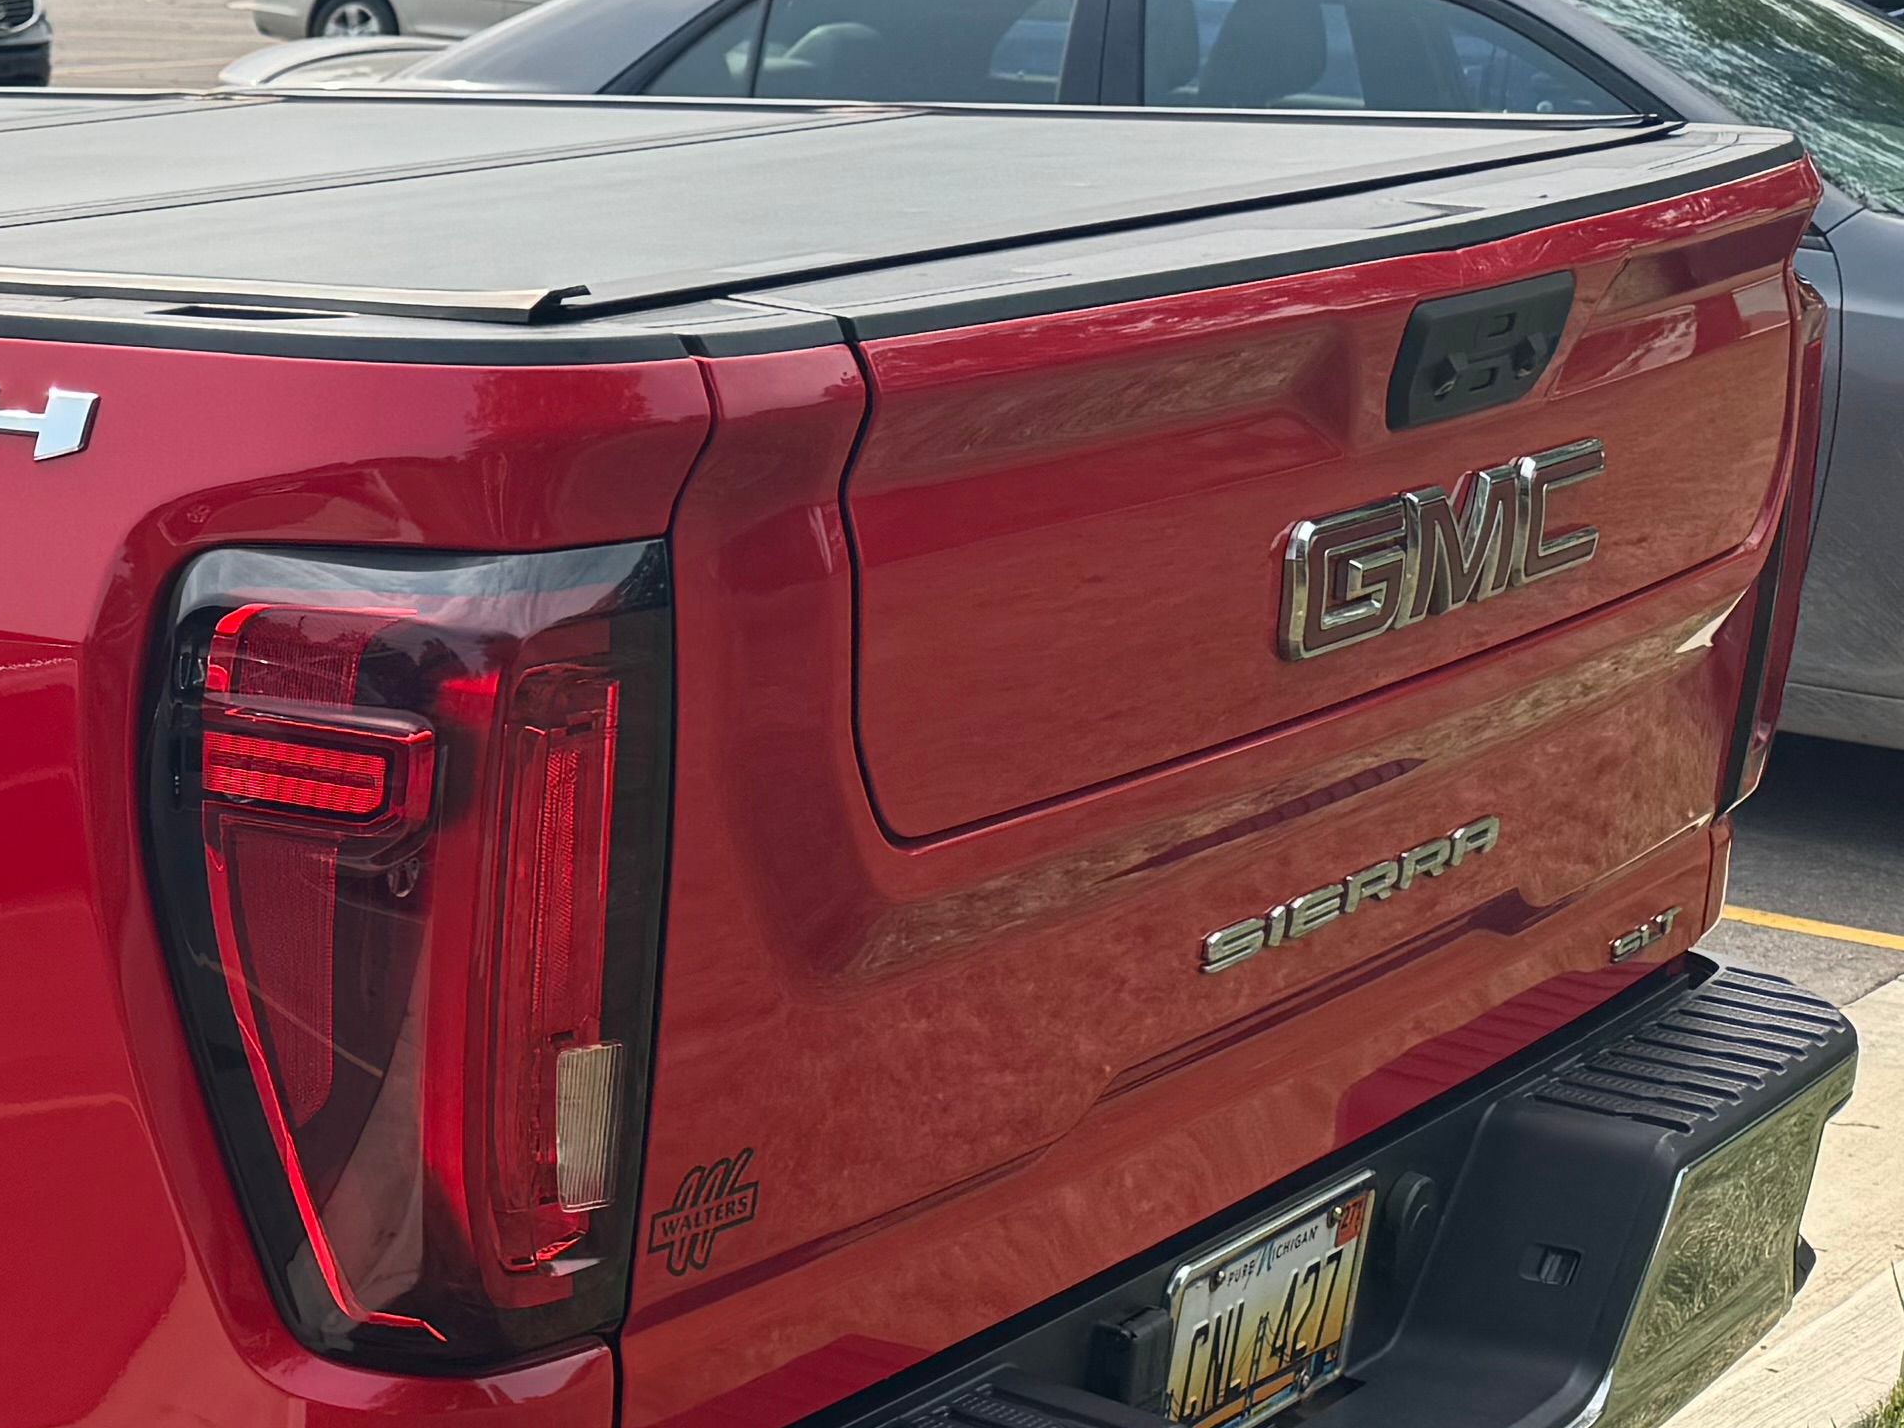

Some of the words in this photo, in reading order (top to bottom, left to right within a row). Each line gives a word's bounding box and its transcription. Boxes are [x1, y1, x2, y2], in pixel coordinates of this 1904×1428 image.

[1276, 436, 1607, 661] GMC
[1200, 815, 1500, 974] SIERRA
[1610, 906, 1682, 963] SLT
[662, 1196, 748, 1237] WALTERS
[1226, 1259, 1257, 1289] PURE
[1256, 1225, 1319, 1277] MICHIGAN
[1178, 1299, 1245, 1422] CNL
[1270, 1246, 1344, 1368] 427
